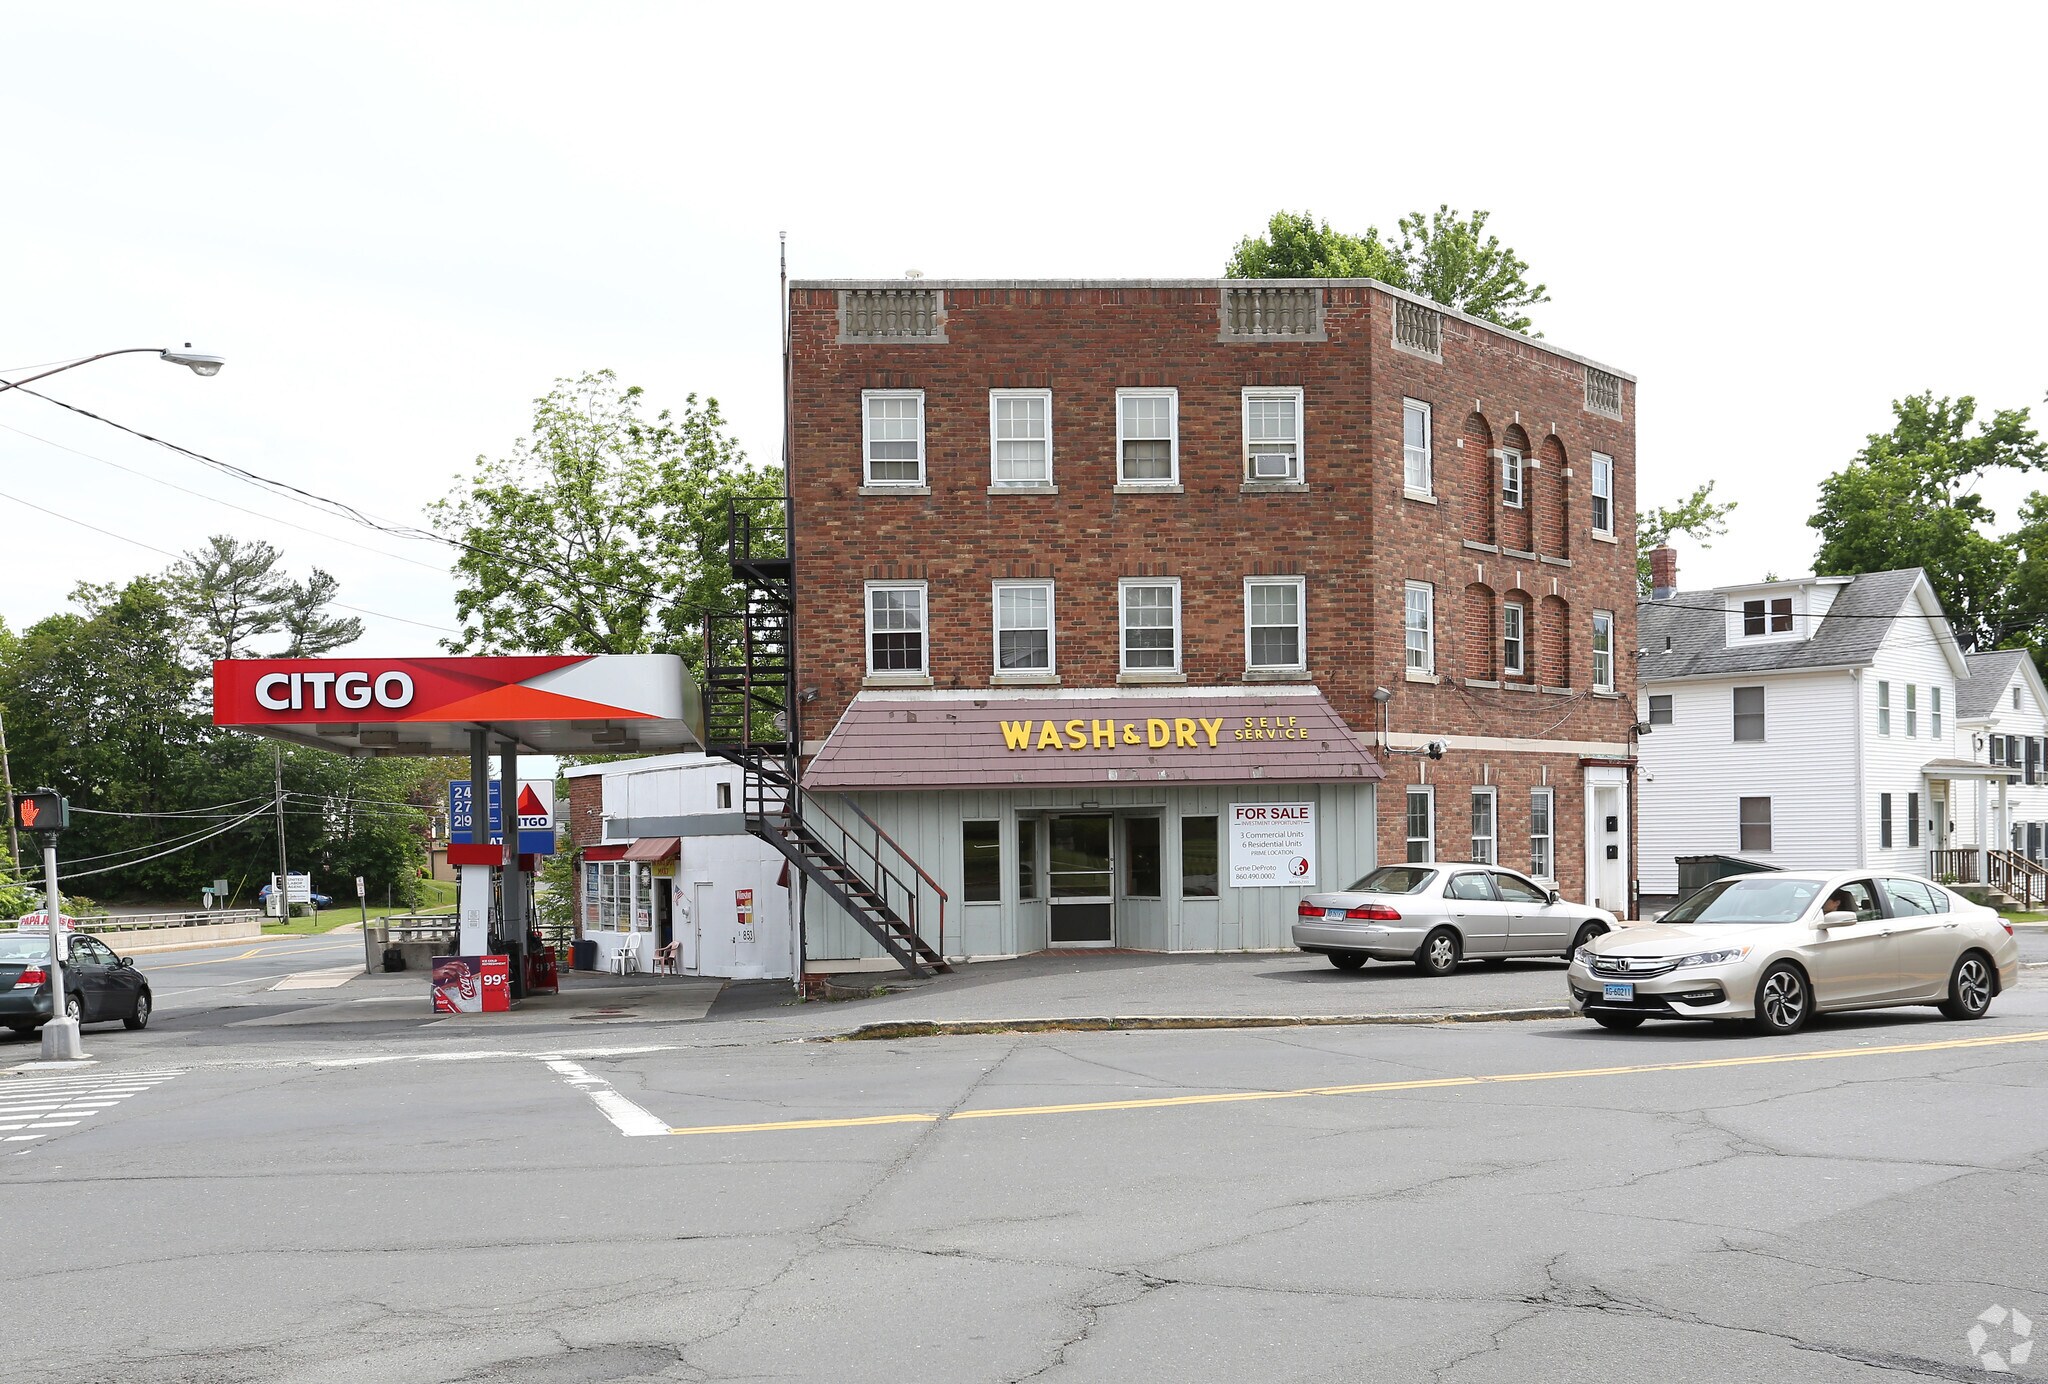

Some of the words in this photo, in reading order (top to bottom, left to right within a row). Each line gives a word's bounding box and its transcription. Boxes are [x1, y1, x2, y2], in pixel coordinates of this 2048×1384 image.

[255, 671, 414, 710] CITGO
[1245, 716, 1297, 728] SELF
[1234, 728, 1308, 740] SERVICE
[1236, 808, 1267, 819] FOR
[1270, 807, 1309, 819] SALE
[518, 817, 548, 826] ITGO
[1245, 831, 1285, 839] Commercial
[1234, 864, 1251, 872] Gene
[1235, 872, 1276, 880] 860.490.0002
[21, 914, 40, 926] PAPA
[483, 973, 507, 986] 99¢
